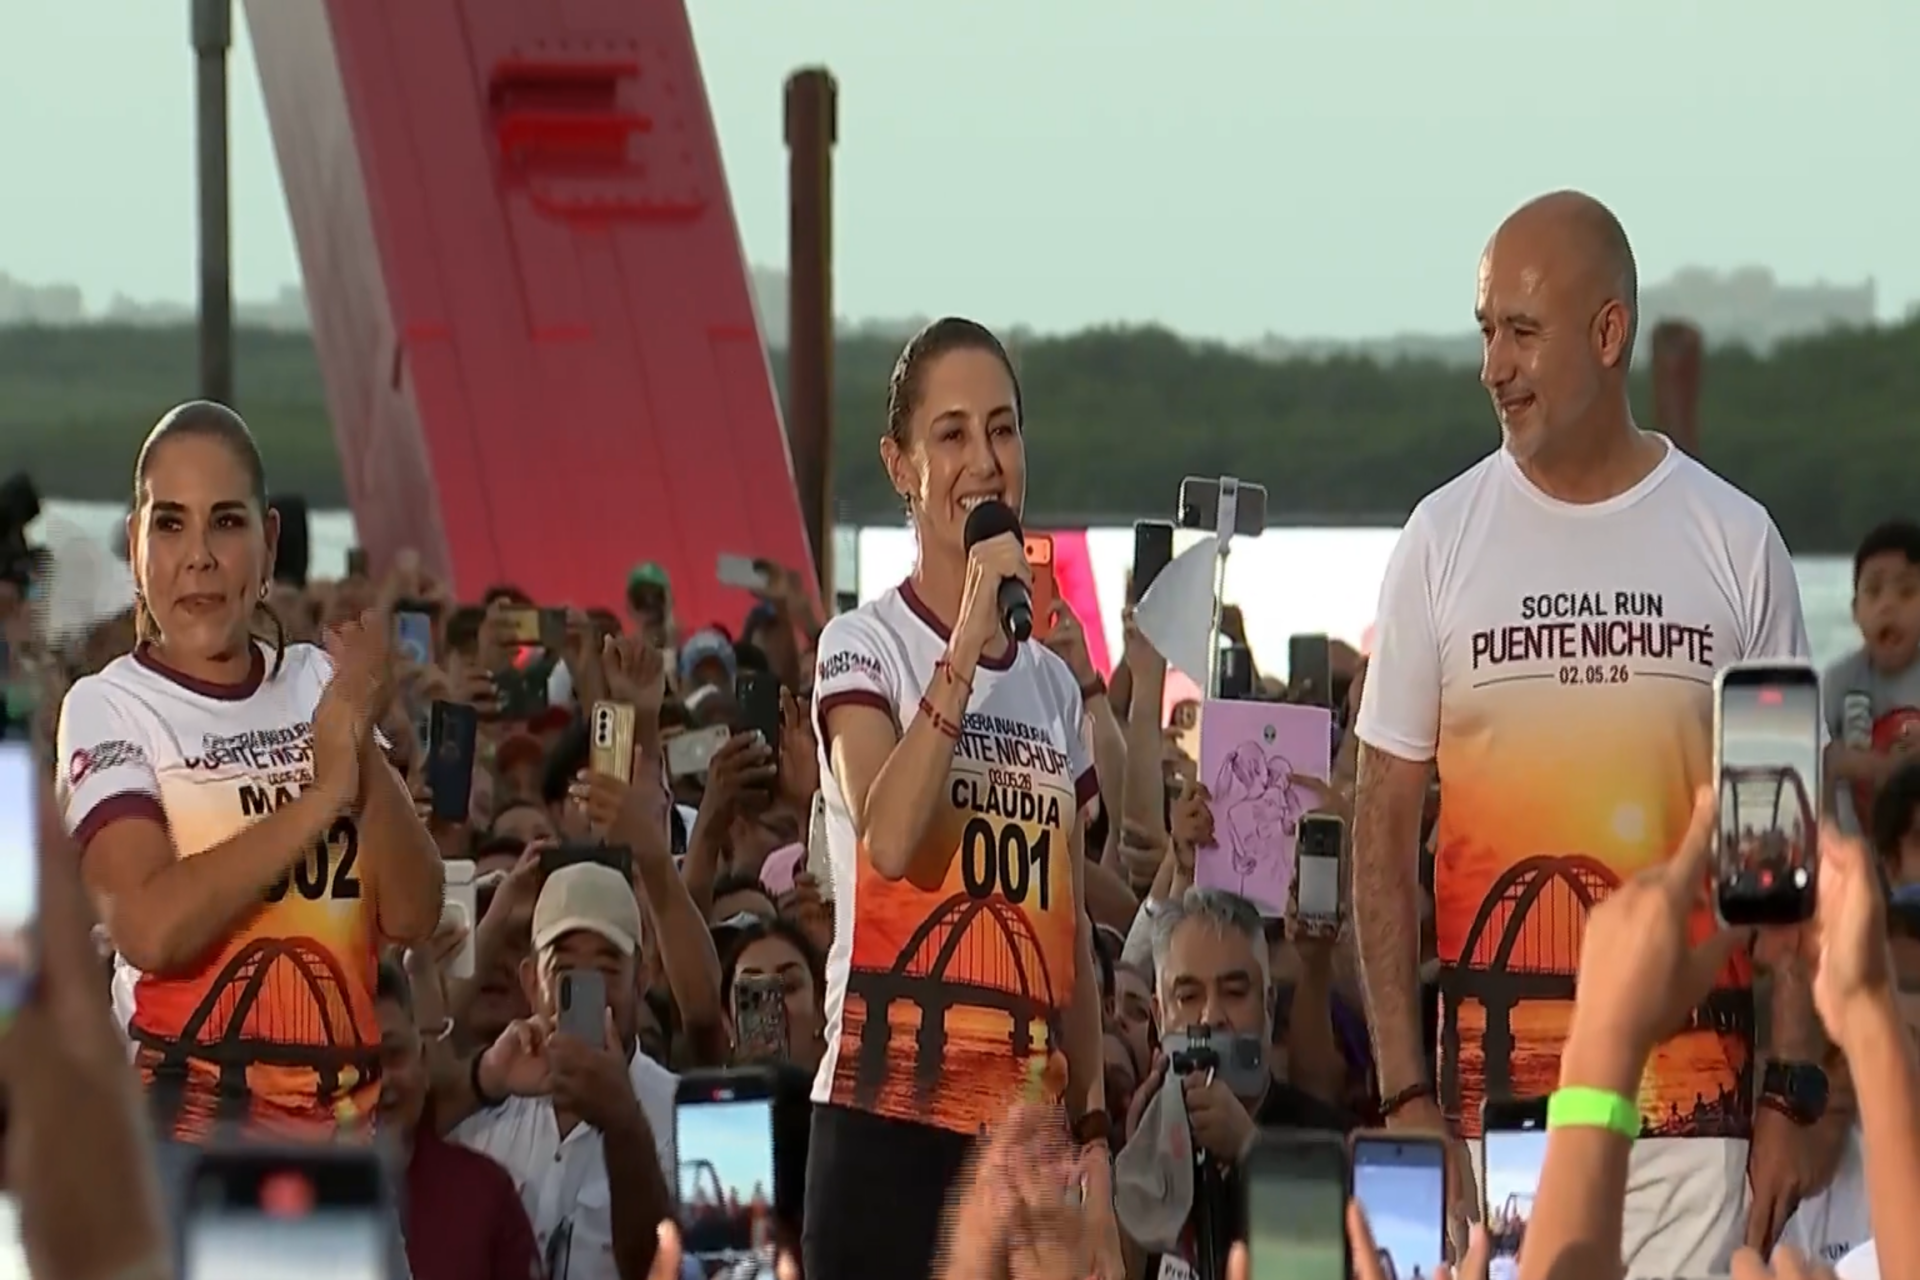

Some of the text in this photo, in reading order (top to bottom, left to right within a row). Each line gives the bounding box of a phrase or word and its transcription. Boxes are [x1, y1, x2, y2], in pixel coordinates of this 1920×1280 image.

[1521, 591, 1663, 619] SOCIAL RUN
[1471, 621, 1714, 669] PUENTE NICHUPTÉ
[1559, 665, 1629, 685] 02.05.26
[995, 736, 1073, 776] NICHUPT
[988, 767, 1032, 791] 03.05.26
[951, 778, 1060, 829] CLAUDIA
[962, 817, 1051, 912] 001
